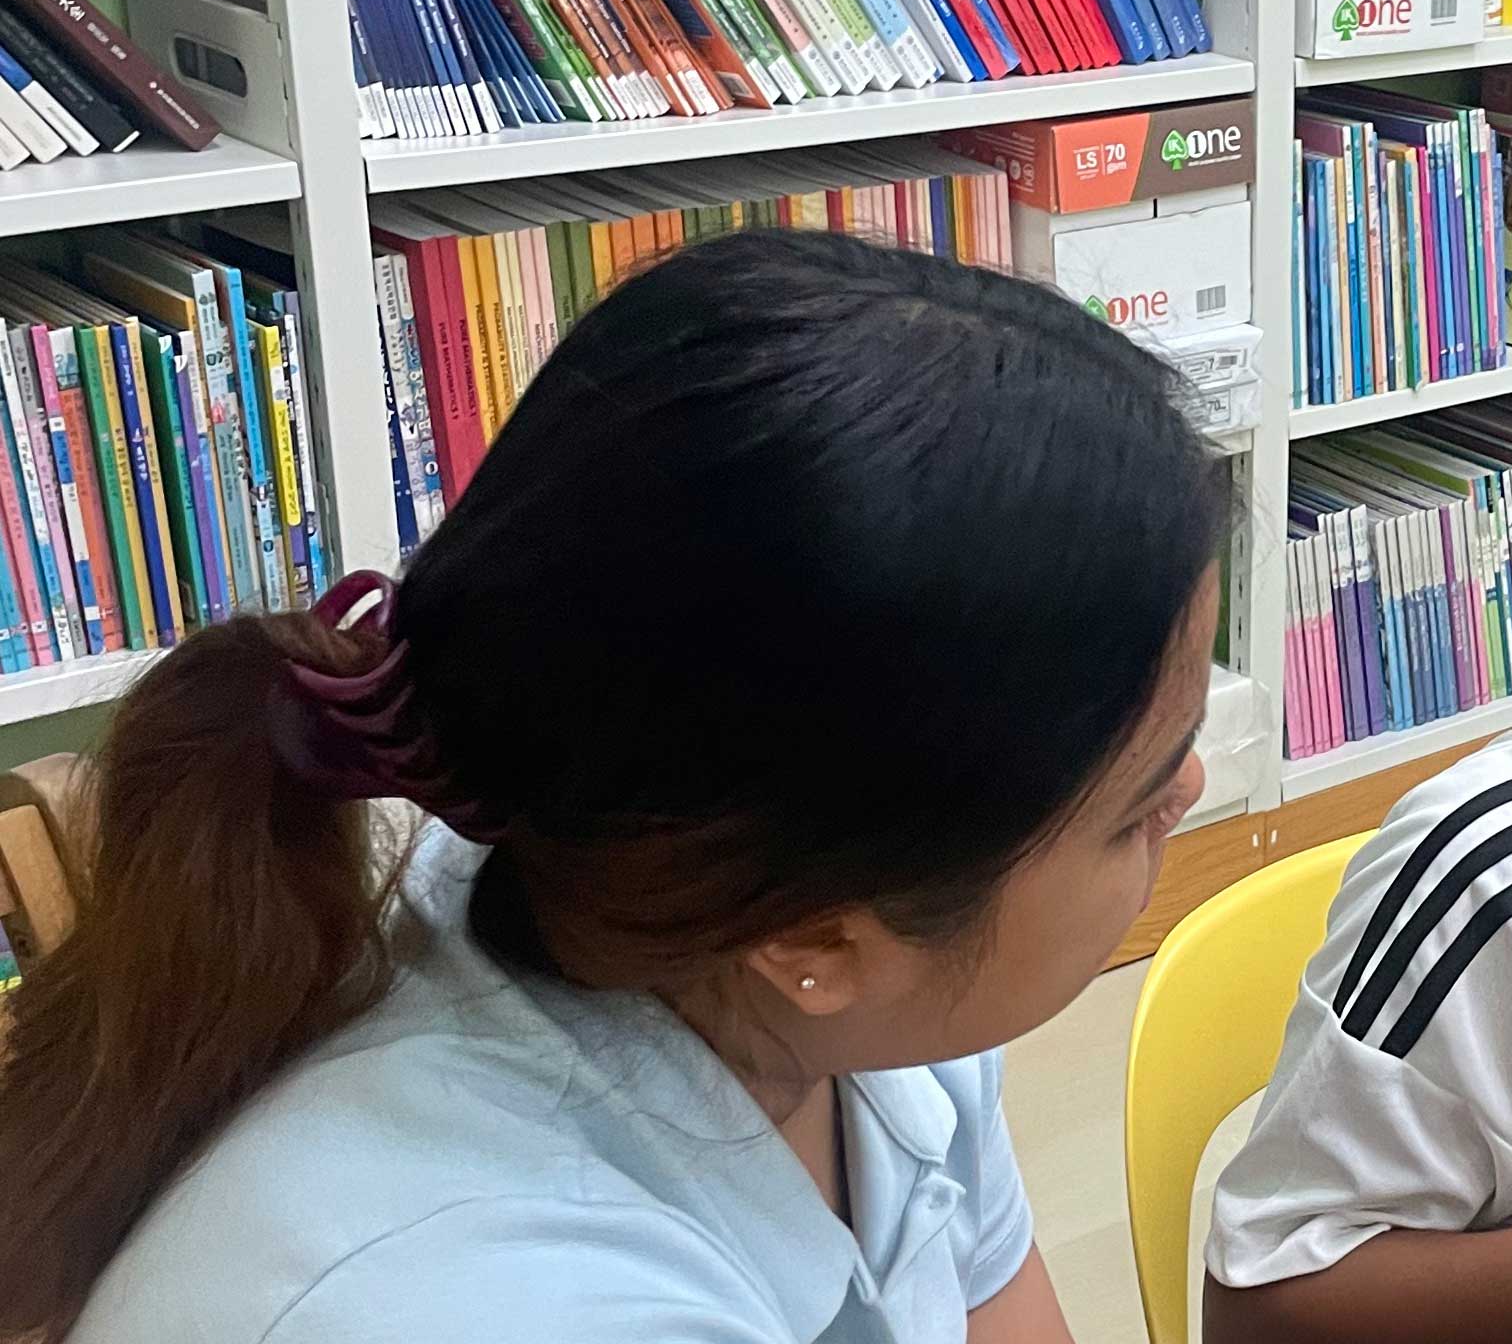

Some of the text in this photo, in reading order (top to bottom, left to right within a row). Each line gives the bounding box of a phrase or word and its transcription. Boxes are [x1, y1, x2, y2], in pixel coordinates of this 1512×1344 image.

[1076, 152, 1096, 170] LS
[1105, 144, 1126, 162] 70
[438, 322, 448, 344] PURE
[457, 319, 467, 343] PURE
[441, 347, 457, 412] MATHEMATICS
[461, 344, 477, 408] MATHEMATICS
